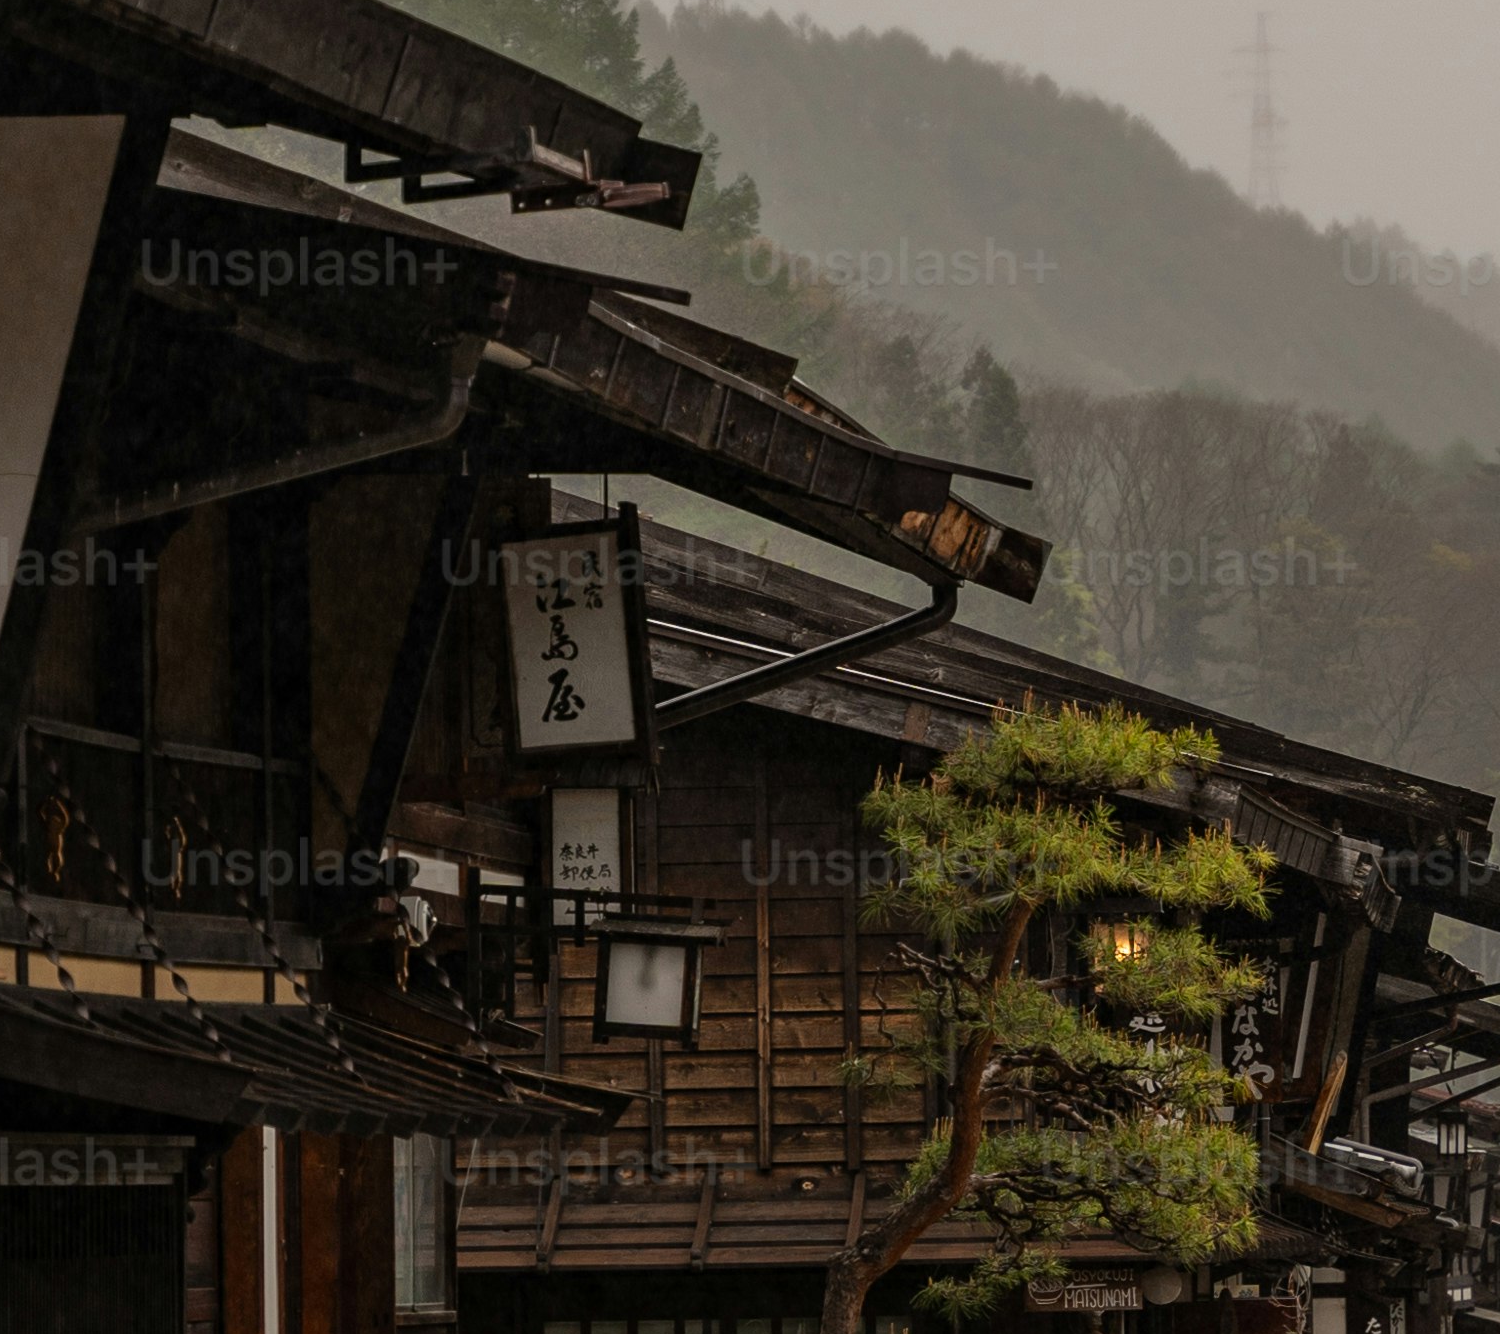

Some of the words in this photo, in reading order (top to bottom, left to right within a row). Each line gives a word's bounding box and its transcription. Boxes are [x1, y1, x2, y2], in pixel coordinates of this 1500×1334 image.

[559, 842, 599, 861] 奈良井
[559, 864, 611, 881] 郵便局
[1072, 1268, 1134, 1283] OSYOKUJI
[1063, 1286, 1138, 1309] MATSUNAMI
